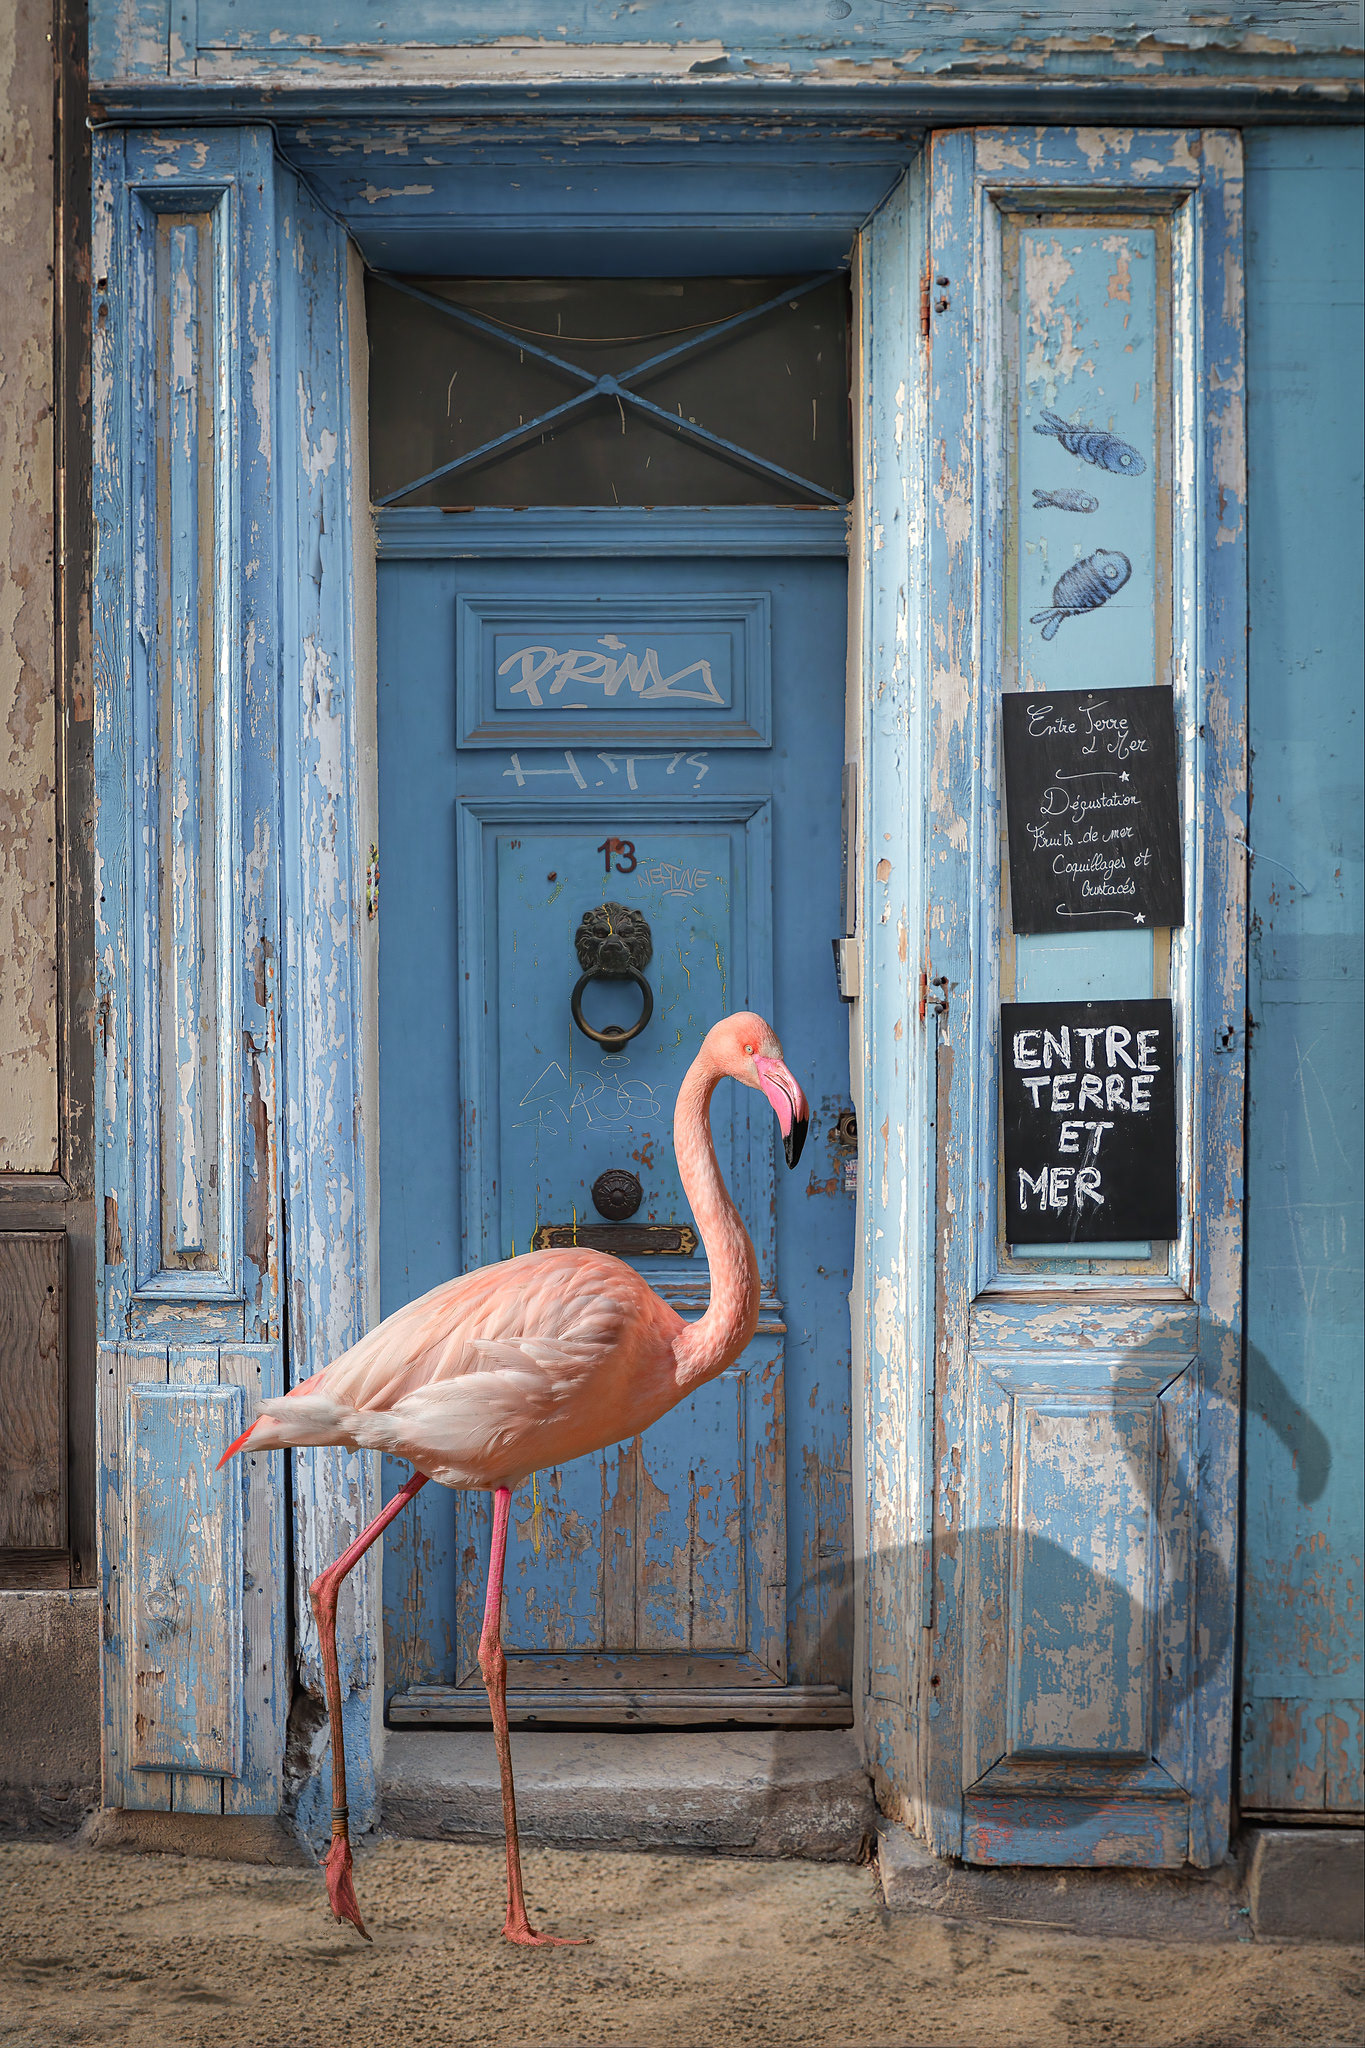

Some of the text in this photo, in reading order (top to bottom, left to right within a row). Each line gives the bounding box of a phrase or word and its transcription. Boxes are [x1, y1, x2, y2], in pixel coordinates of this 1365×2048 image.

[1026, 700, 1129, 737] Entre Terre
[1107, 730, 1150, 760] Mer
[1039, 786, 1142, 824] Dégustation
[1026, 821, 1135, 852] Fruits de mer
[597, 837, 638, 874] 13
[1052, 847, 1153, 882] Coquillages et
[1013, 1025, 1161, 1072] ENTRE
[1022, 1072, 1155, 1113] TERRE
[1058, 1120, 1115, 1155] ET
[1017, 1163, 1105, 1211] MER
